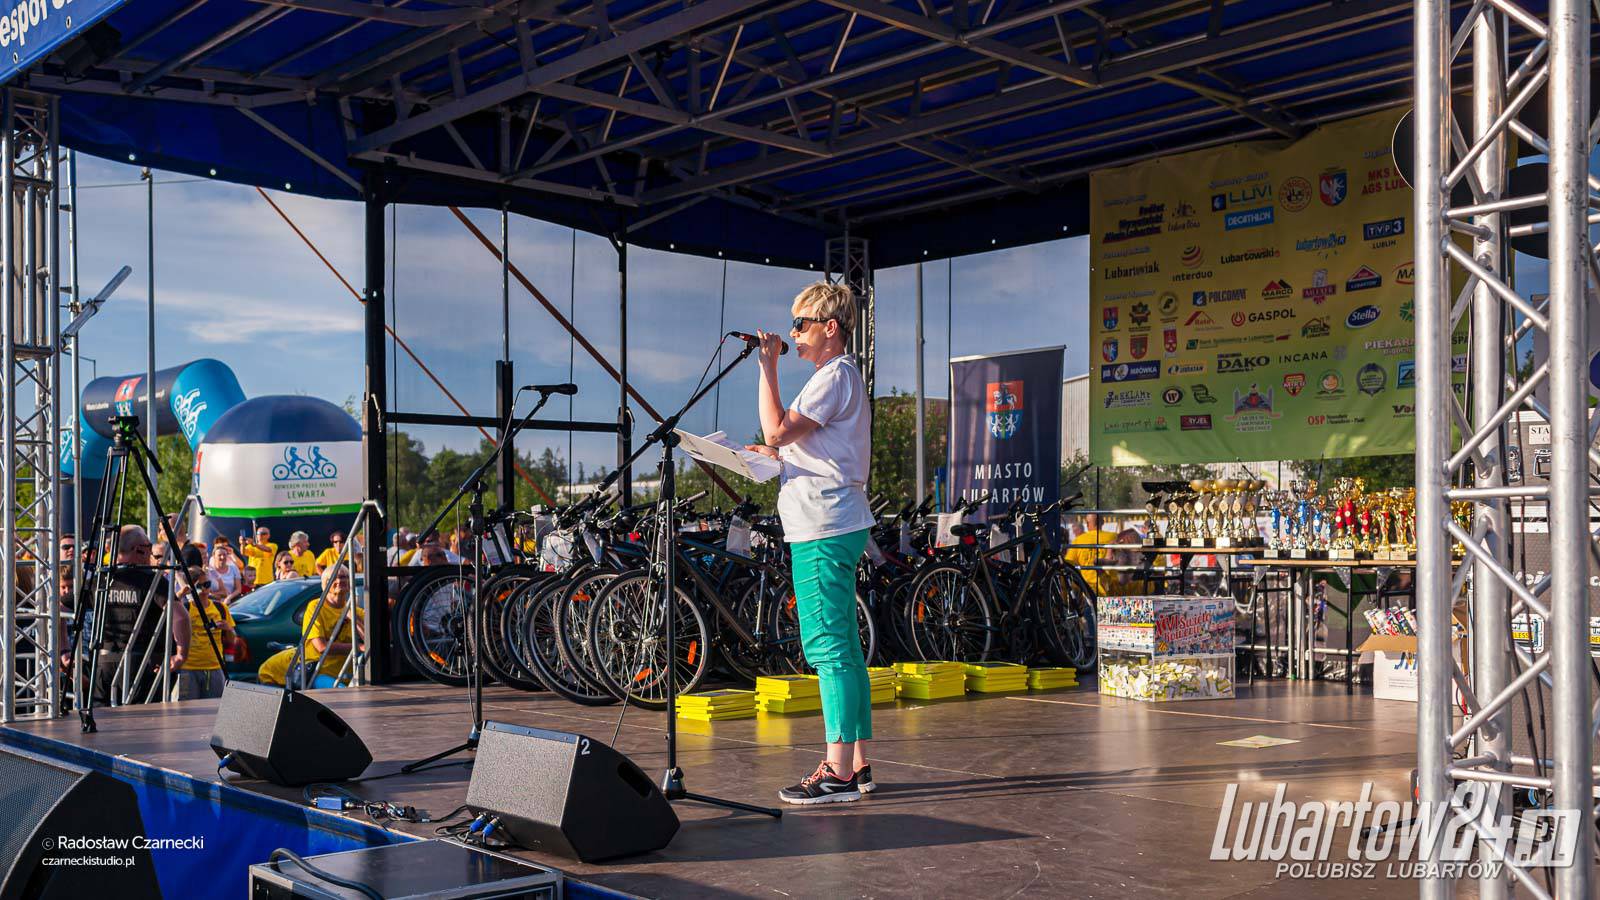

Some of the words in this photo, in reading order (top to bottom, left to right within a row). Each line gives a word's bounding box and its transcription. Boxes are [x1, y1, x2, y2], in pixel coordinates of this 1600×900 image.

[1368, 168, 1390, 181] MKS
[1361, 181, 1383, 195] AGS
[1227, 212, 1271, 226] DECATHLON
[1172, 271, 1213, 282] interduo
[1248, 308, 1296, 322] GASPOL
[1351, 308, 1377, 322] Stella
[1217, 355, 1270, 370] DAKO
[1278, 351, 1328, 364] INCANA
[1307, 415, 1326, 425] OSP
[975, 462, 1032, 480] MIASTO
[287, 490, 326, 500] LEWARTA
[962, 484, 1046, 504] LUBARTÓW
[287, 692, 293, 703] 1
[580, 738, 591, 756] 2
